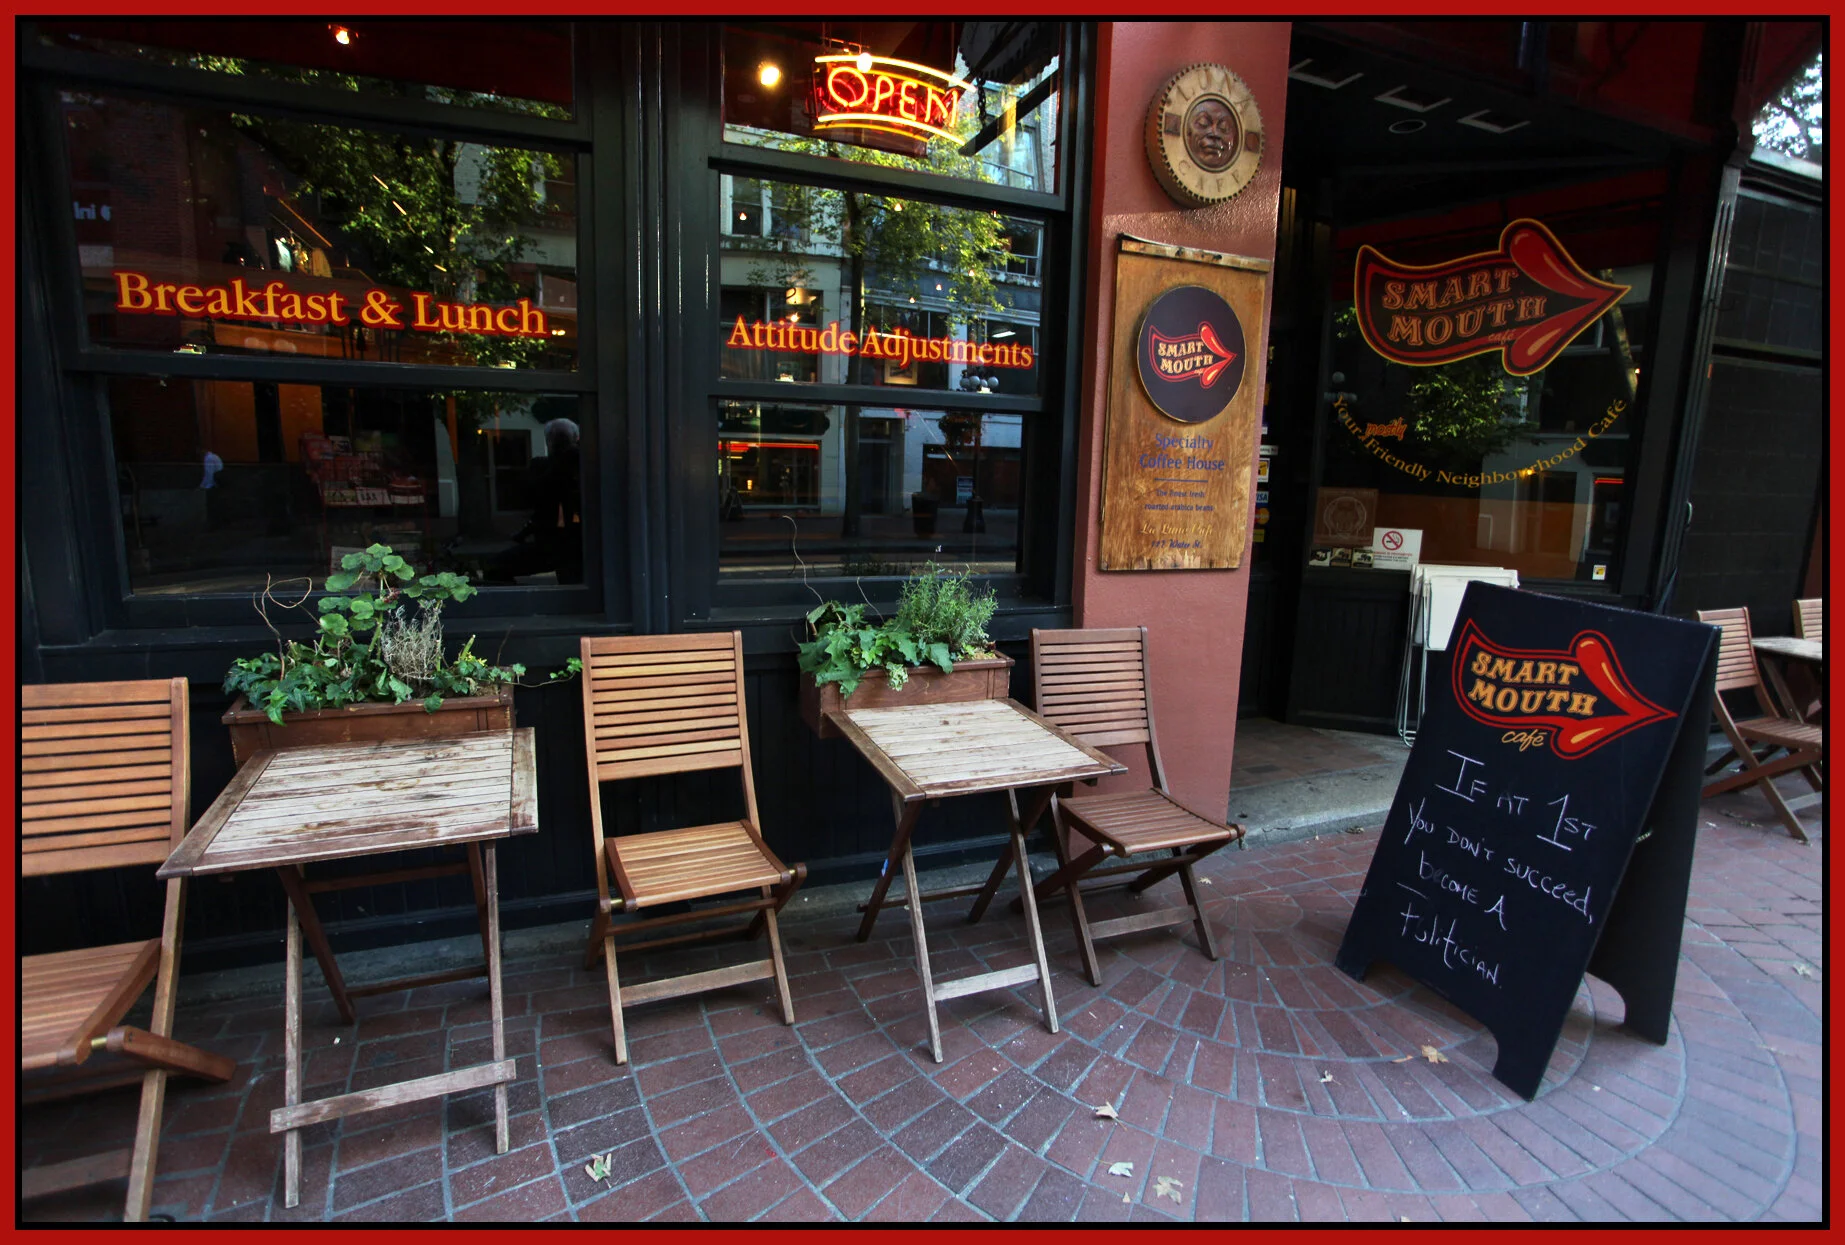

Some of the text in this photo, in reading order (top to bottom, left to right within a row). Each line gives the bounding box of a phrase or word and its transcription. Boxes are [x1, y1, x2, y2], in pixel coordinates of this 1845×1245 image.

[827, 66, 958, 128] OPEN
[1176, 68, 1251, 116] LUNA
[114, 271, 549, 336] Breakfast & Lunch
[1382, 267, 1519, 310] SMART
[1387, 296, 1548, 346] MOUTH
[727, 315, 1034, 368] Attitude Adjustments
[1158, 340, 1204, 358] SMART
[1160, 354, 1214, 374] MOUTH
[1333, 395, 1362, 434] Your
[1365, 416, 1408, 440] mostly
[1155, 432, 1214, 453] Specialty
[1365, 438, 1432, 481] Friendly
[1140, 453, 1225, 471] Coffee House
[1436, 437, 1588, 488] Neighbourhood
[1144, 503, 1169, 511] roasted
[1256, 492, 1268, 501] ISA
[1471, 651, 1579, 685] SMART
[1468, 678, 1598, 716] MOUTH
[1501, 729, 1547, 752] café
[1435, 750, 1598, 851] IF AT 1ST
[1404, 798, 1434, 845] YOU
[1446, 826, 1495, 861] DON'T
[1484, 895, 1508, 931] A
